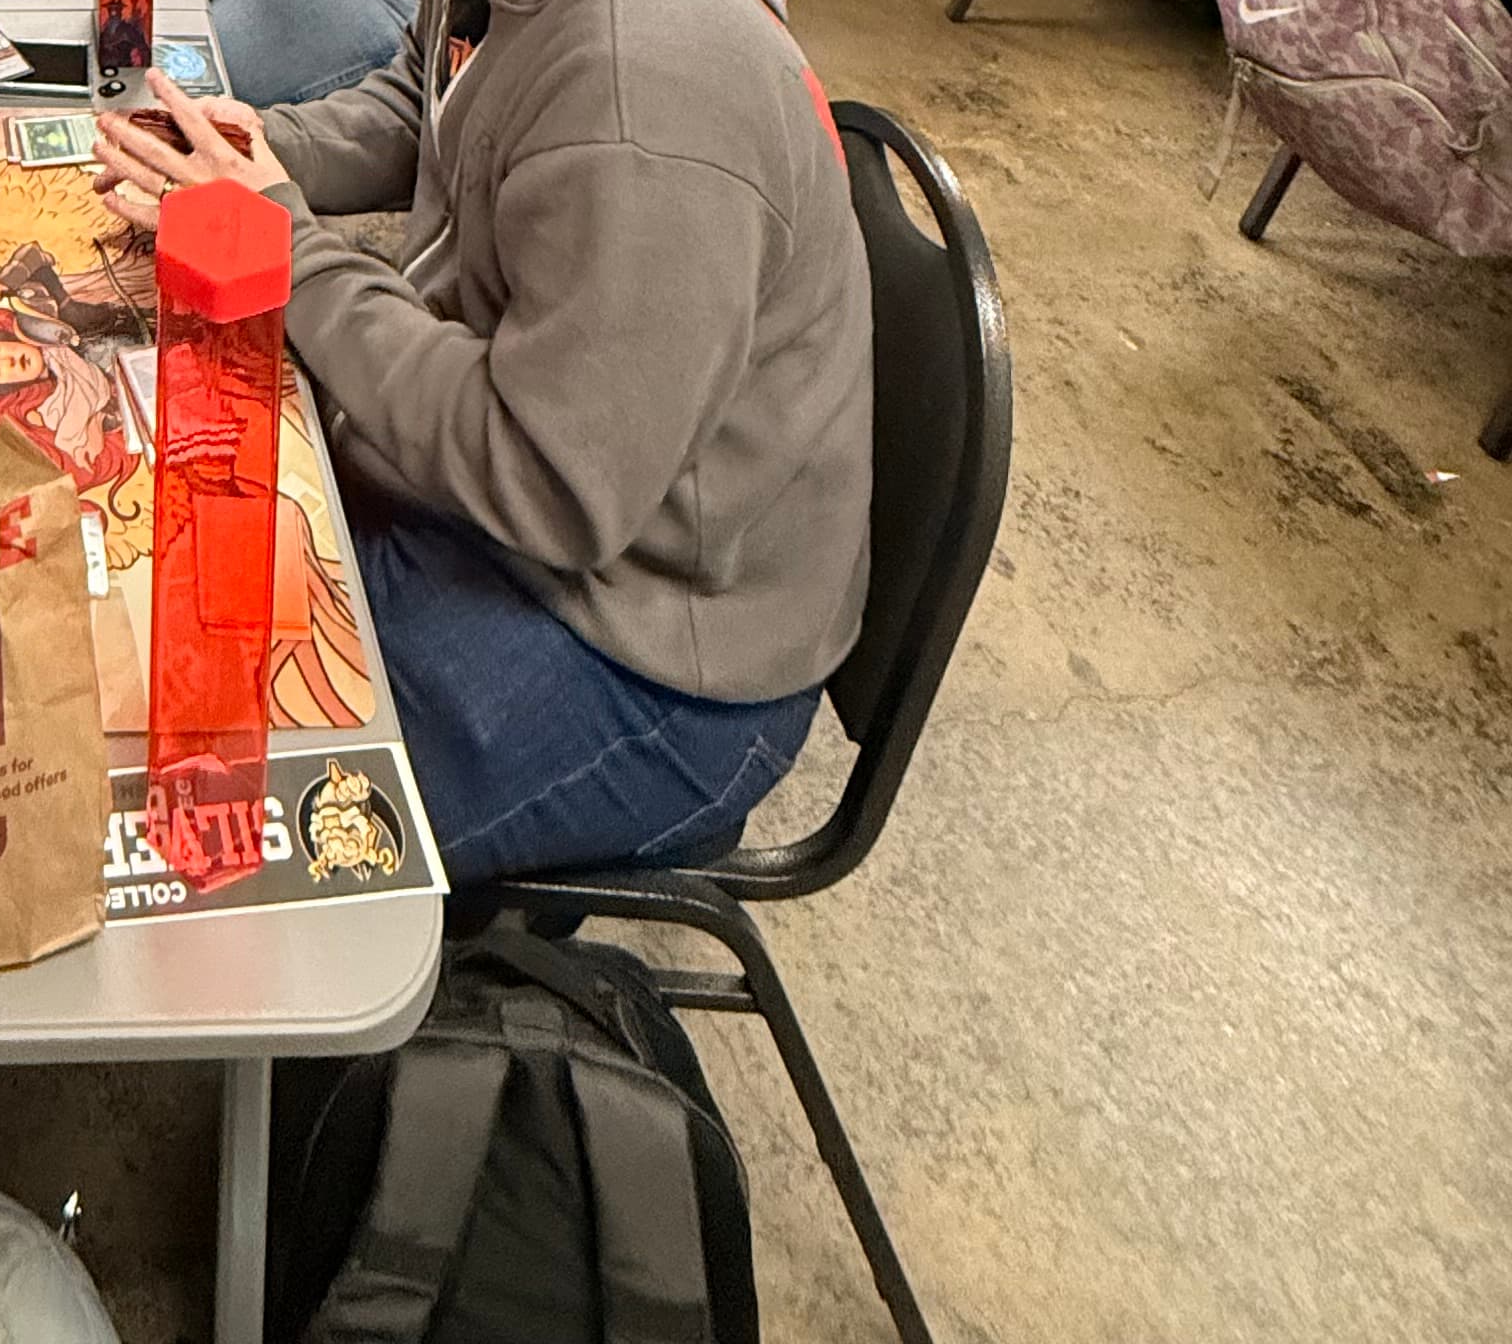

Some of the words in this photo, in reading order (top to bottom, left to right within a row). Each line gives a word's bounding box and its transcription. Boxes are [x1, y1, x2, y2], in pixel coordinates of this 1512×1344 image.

[11, 757, 34, 773] for
[24, 768, 68, 793] offers
[105, 880, 187, 910] COLLE
